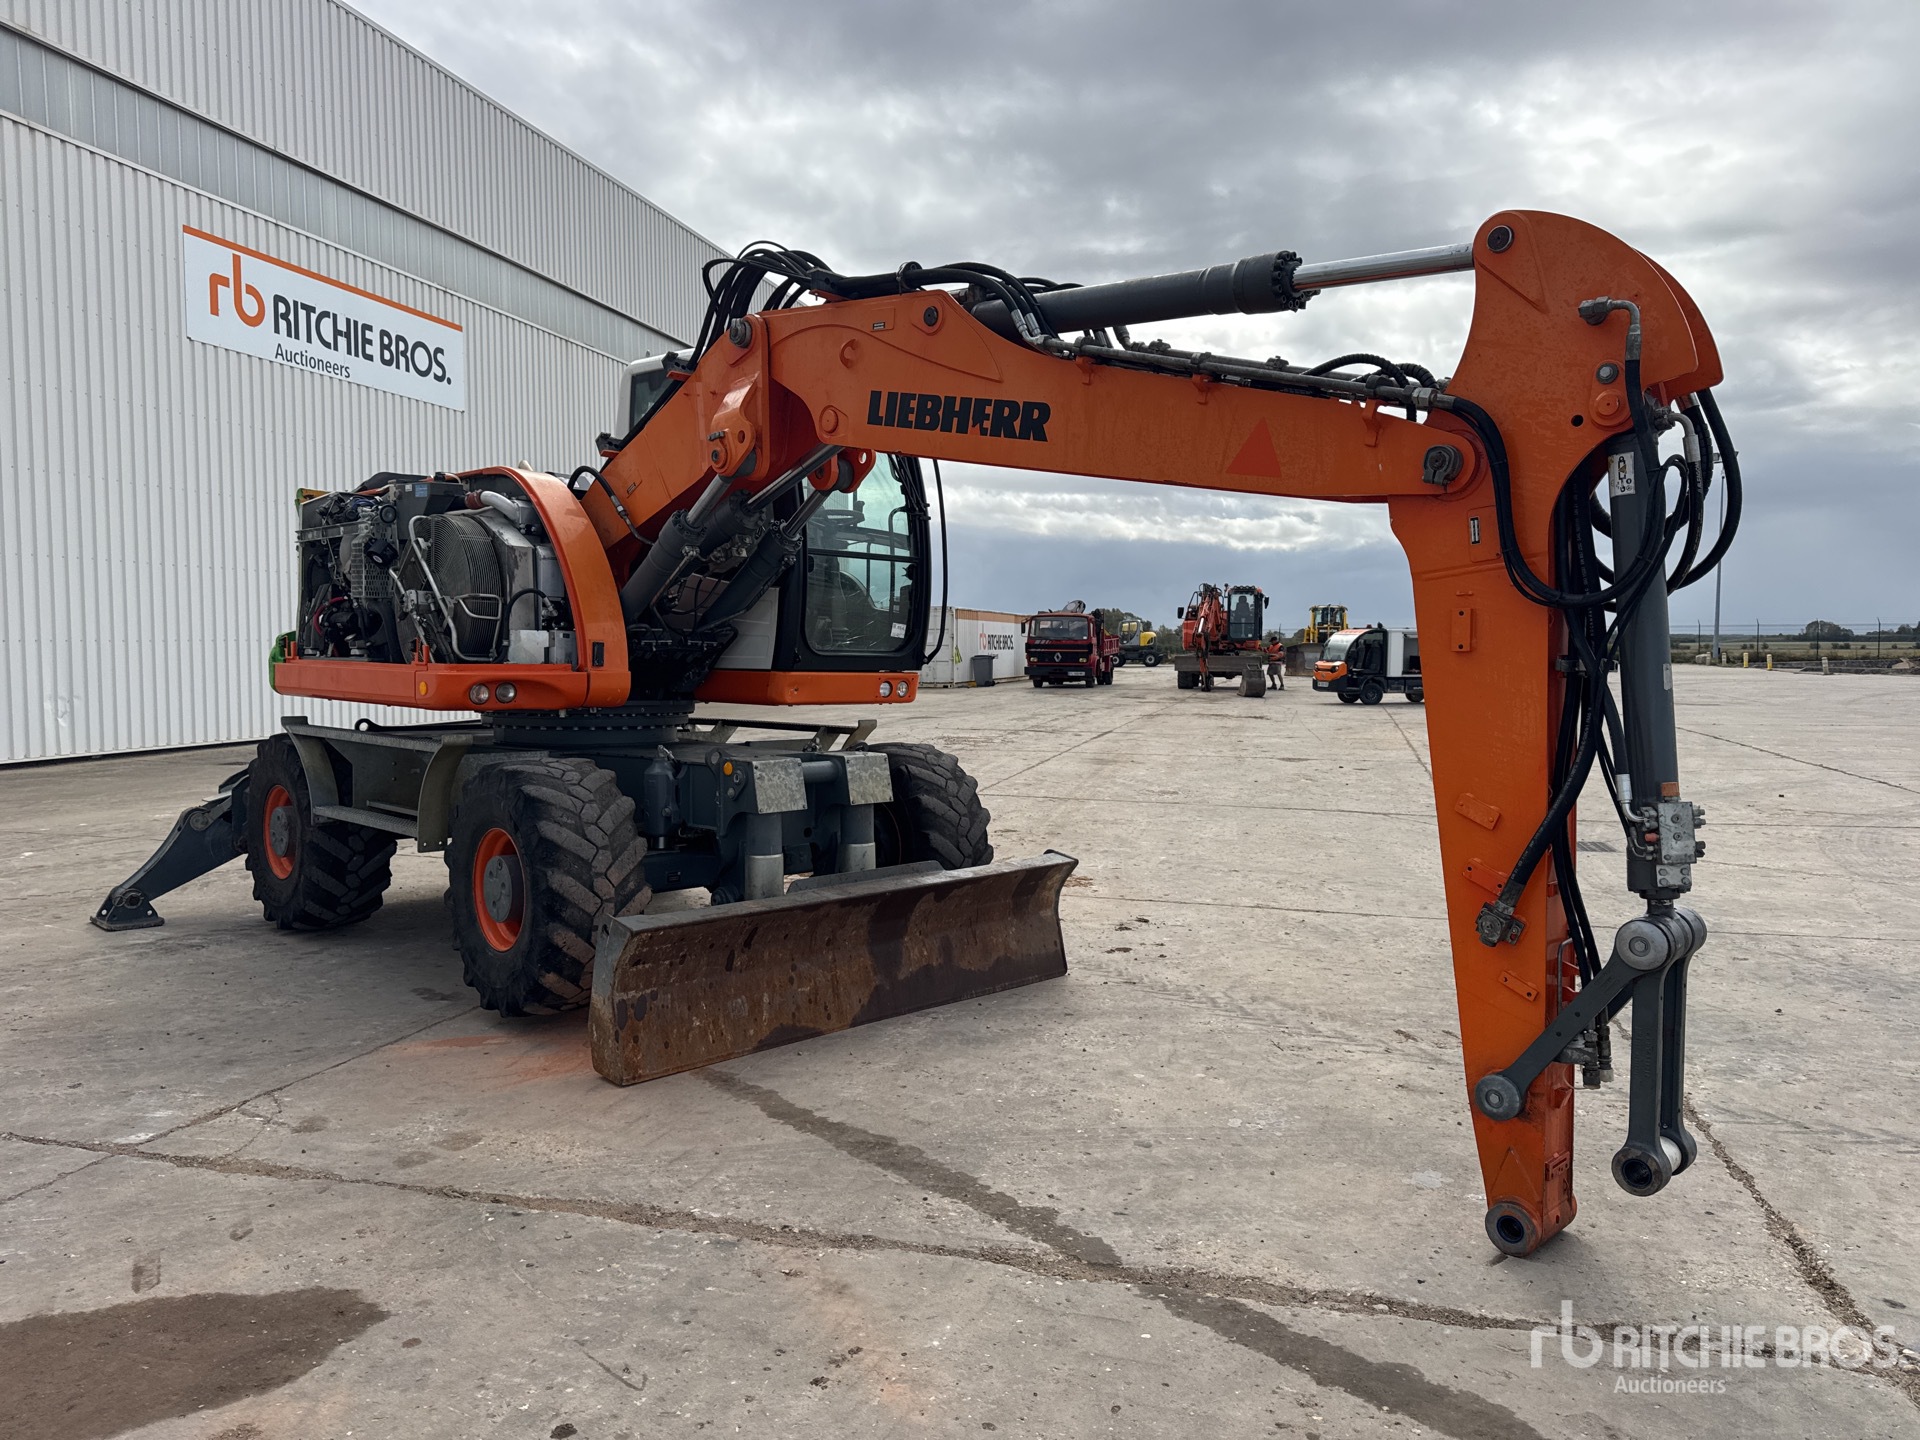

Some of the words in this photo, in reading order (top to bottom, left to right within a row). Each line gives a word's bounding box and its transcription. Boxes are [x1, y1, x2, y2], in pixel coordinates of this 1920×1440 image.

[209, 253, 266, 328] rb
[273, 294, 374, 362] RITCHIE
[379, 328, 452, 385] BROS.
[274, 343, 351, 379] Auctioneers
[867, 390, 1051, 442] LIEBHERR
